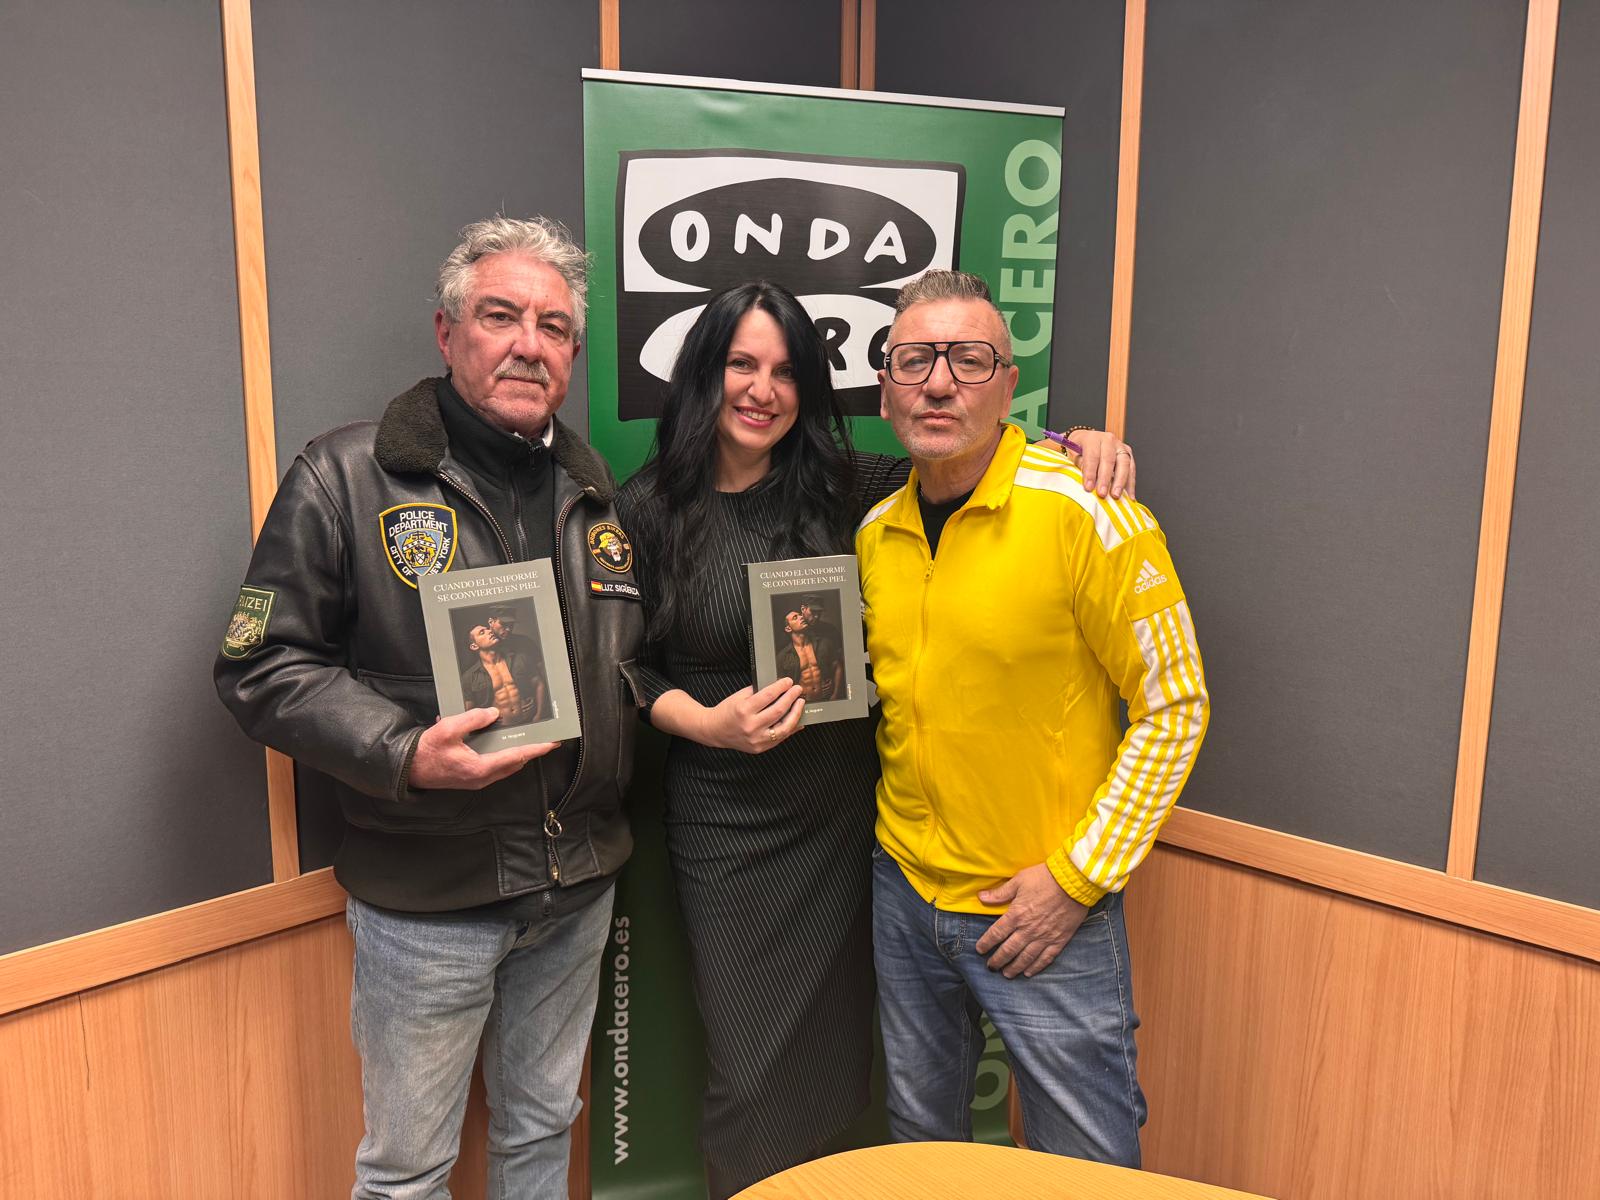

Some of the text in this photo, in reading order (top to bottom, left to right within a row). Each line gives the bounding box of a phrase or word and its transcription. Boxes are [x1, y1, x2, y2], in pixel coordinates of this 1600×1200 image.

[669, 210, 907, 264] ONDA
[1000, 139, 1062, 357] CERO
[399, 510, 435, 521] POLICE
[388, 519, 448, 538] DEPARTMENT
[438, 537, 451, 559] YORK
[390, 545, 413, 576] CITY OF
[433, 570, 539, 593] CUANDO EL UNIFORME
[760, 565, 846, 579] CUANDO EL UNIFORME
[772, 577, 817, 588] CONVIERTE
[816, 576, 829, 584] EN
[829, 575, 847, 583] PIEL
[437, 581, 541, 602] SE CONVIERTE EN PIEL
[600, 583, 615, 592] LUZ
[1134, 574, 1168, 594] adidas
[606, 915, 630, 1165] www.ondacero.es
